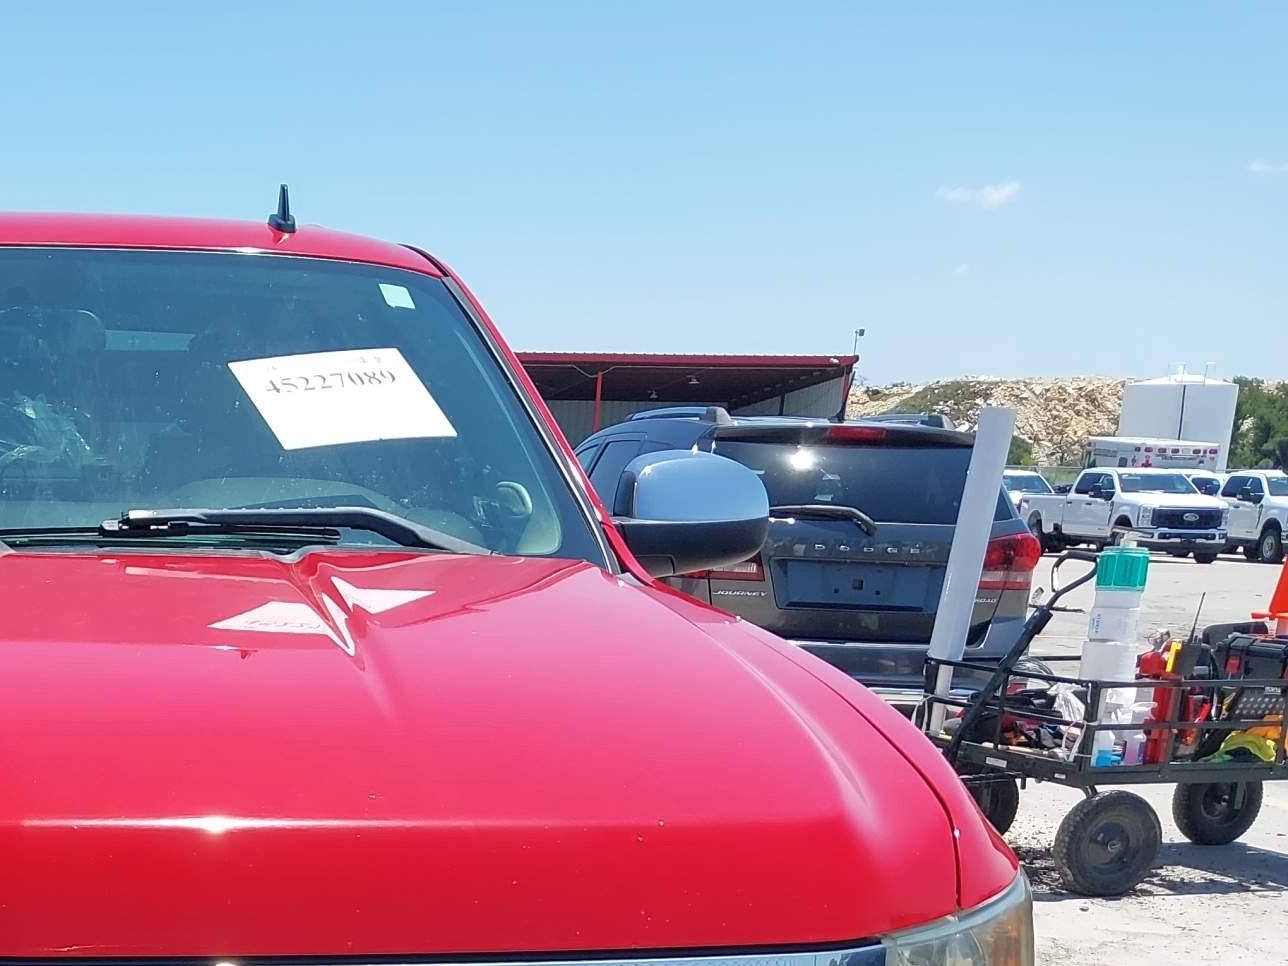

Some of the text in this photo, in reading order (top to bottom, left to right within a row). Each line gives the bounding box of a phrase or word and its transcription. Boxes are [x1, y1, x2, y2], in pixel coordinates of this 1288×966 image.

[265, 369, 396, 393] 45227089
[814, 543, 921, 554] DODGE
[712, 589, 768, 597] JOURNEY
